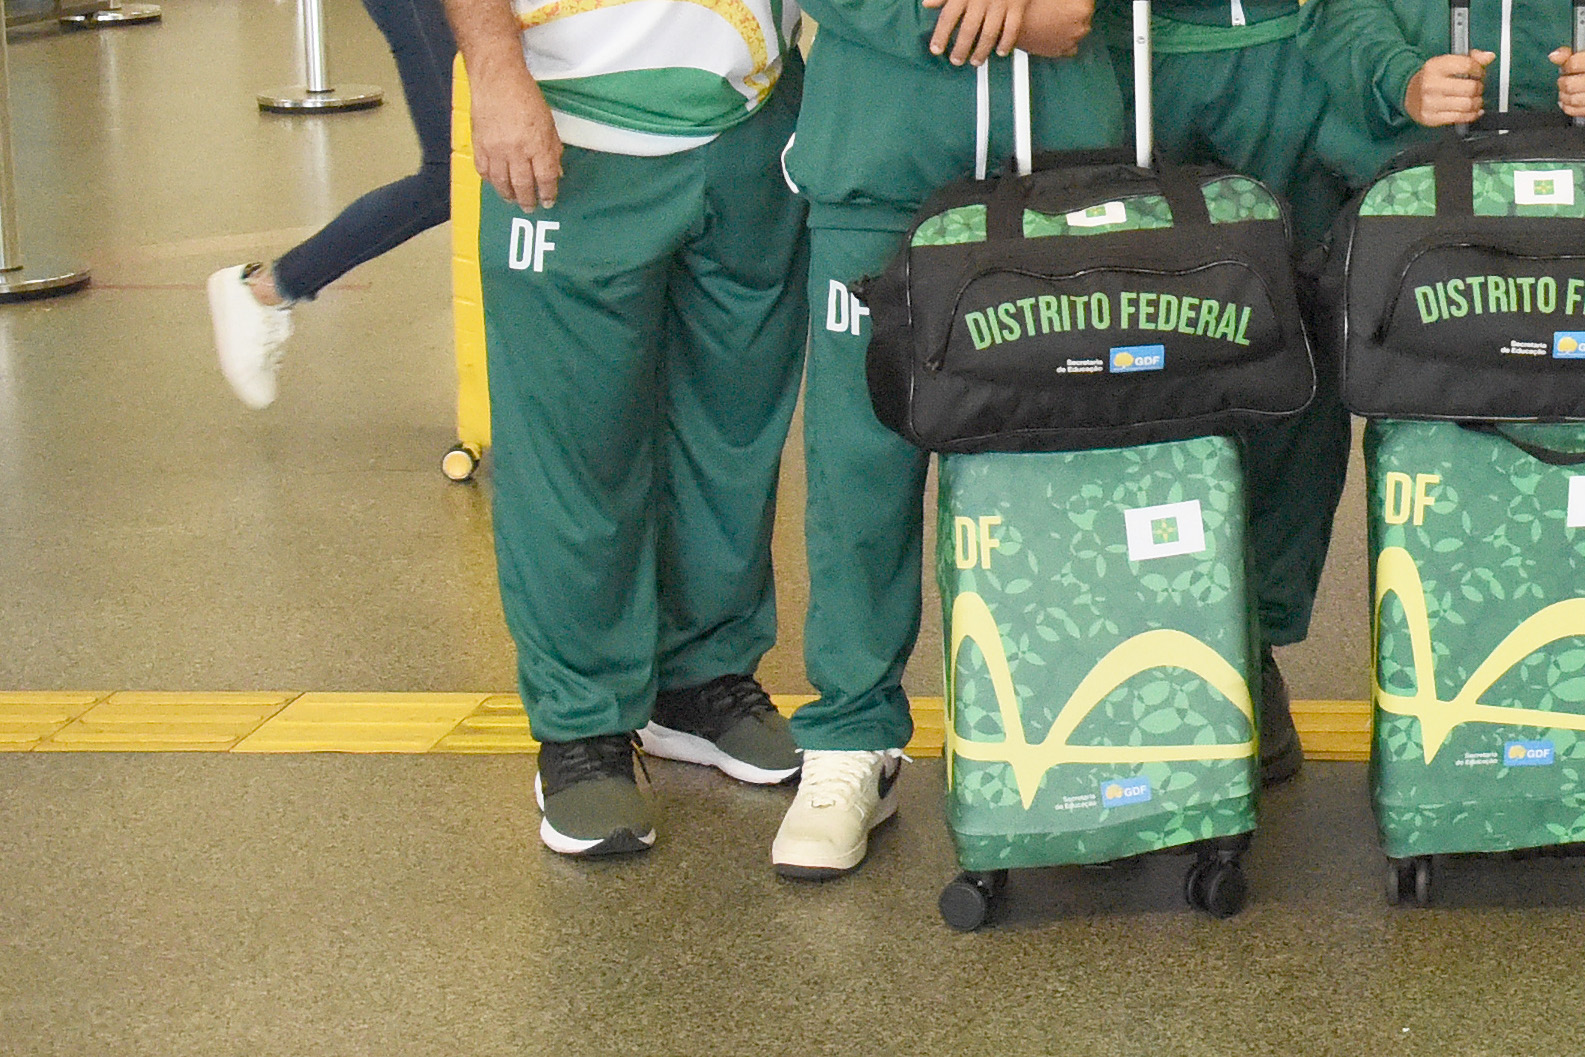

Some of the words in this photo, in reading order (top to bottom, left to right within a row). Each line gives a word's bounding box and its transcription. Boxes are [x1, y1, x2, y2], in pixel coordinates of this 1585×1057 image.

[509, 217, 560, 273] DF
[964, 291, 1111, 351] DISTRITO
[1120, 291, 1253, 346] FEDERAL
[1415, 275, 1557, 325] DISTRITO
[1134, 355, 1160, 366] GDF
[1384, 471, 1440, 526] DF
[954, 515, 1002, 570] DF
[1526, 748, 1551, 758] GDF
[1123, 785, 1147, 797] GDF
